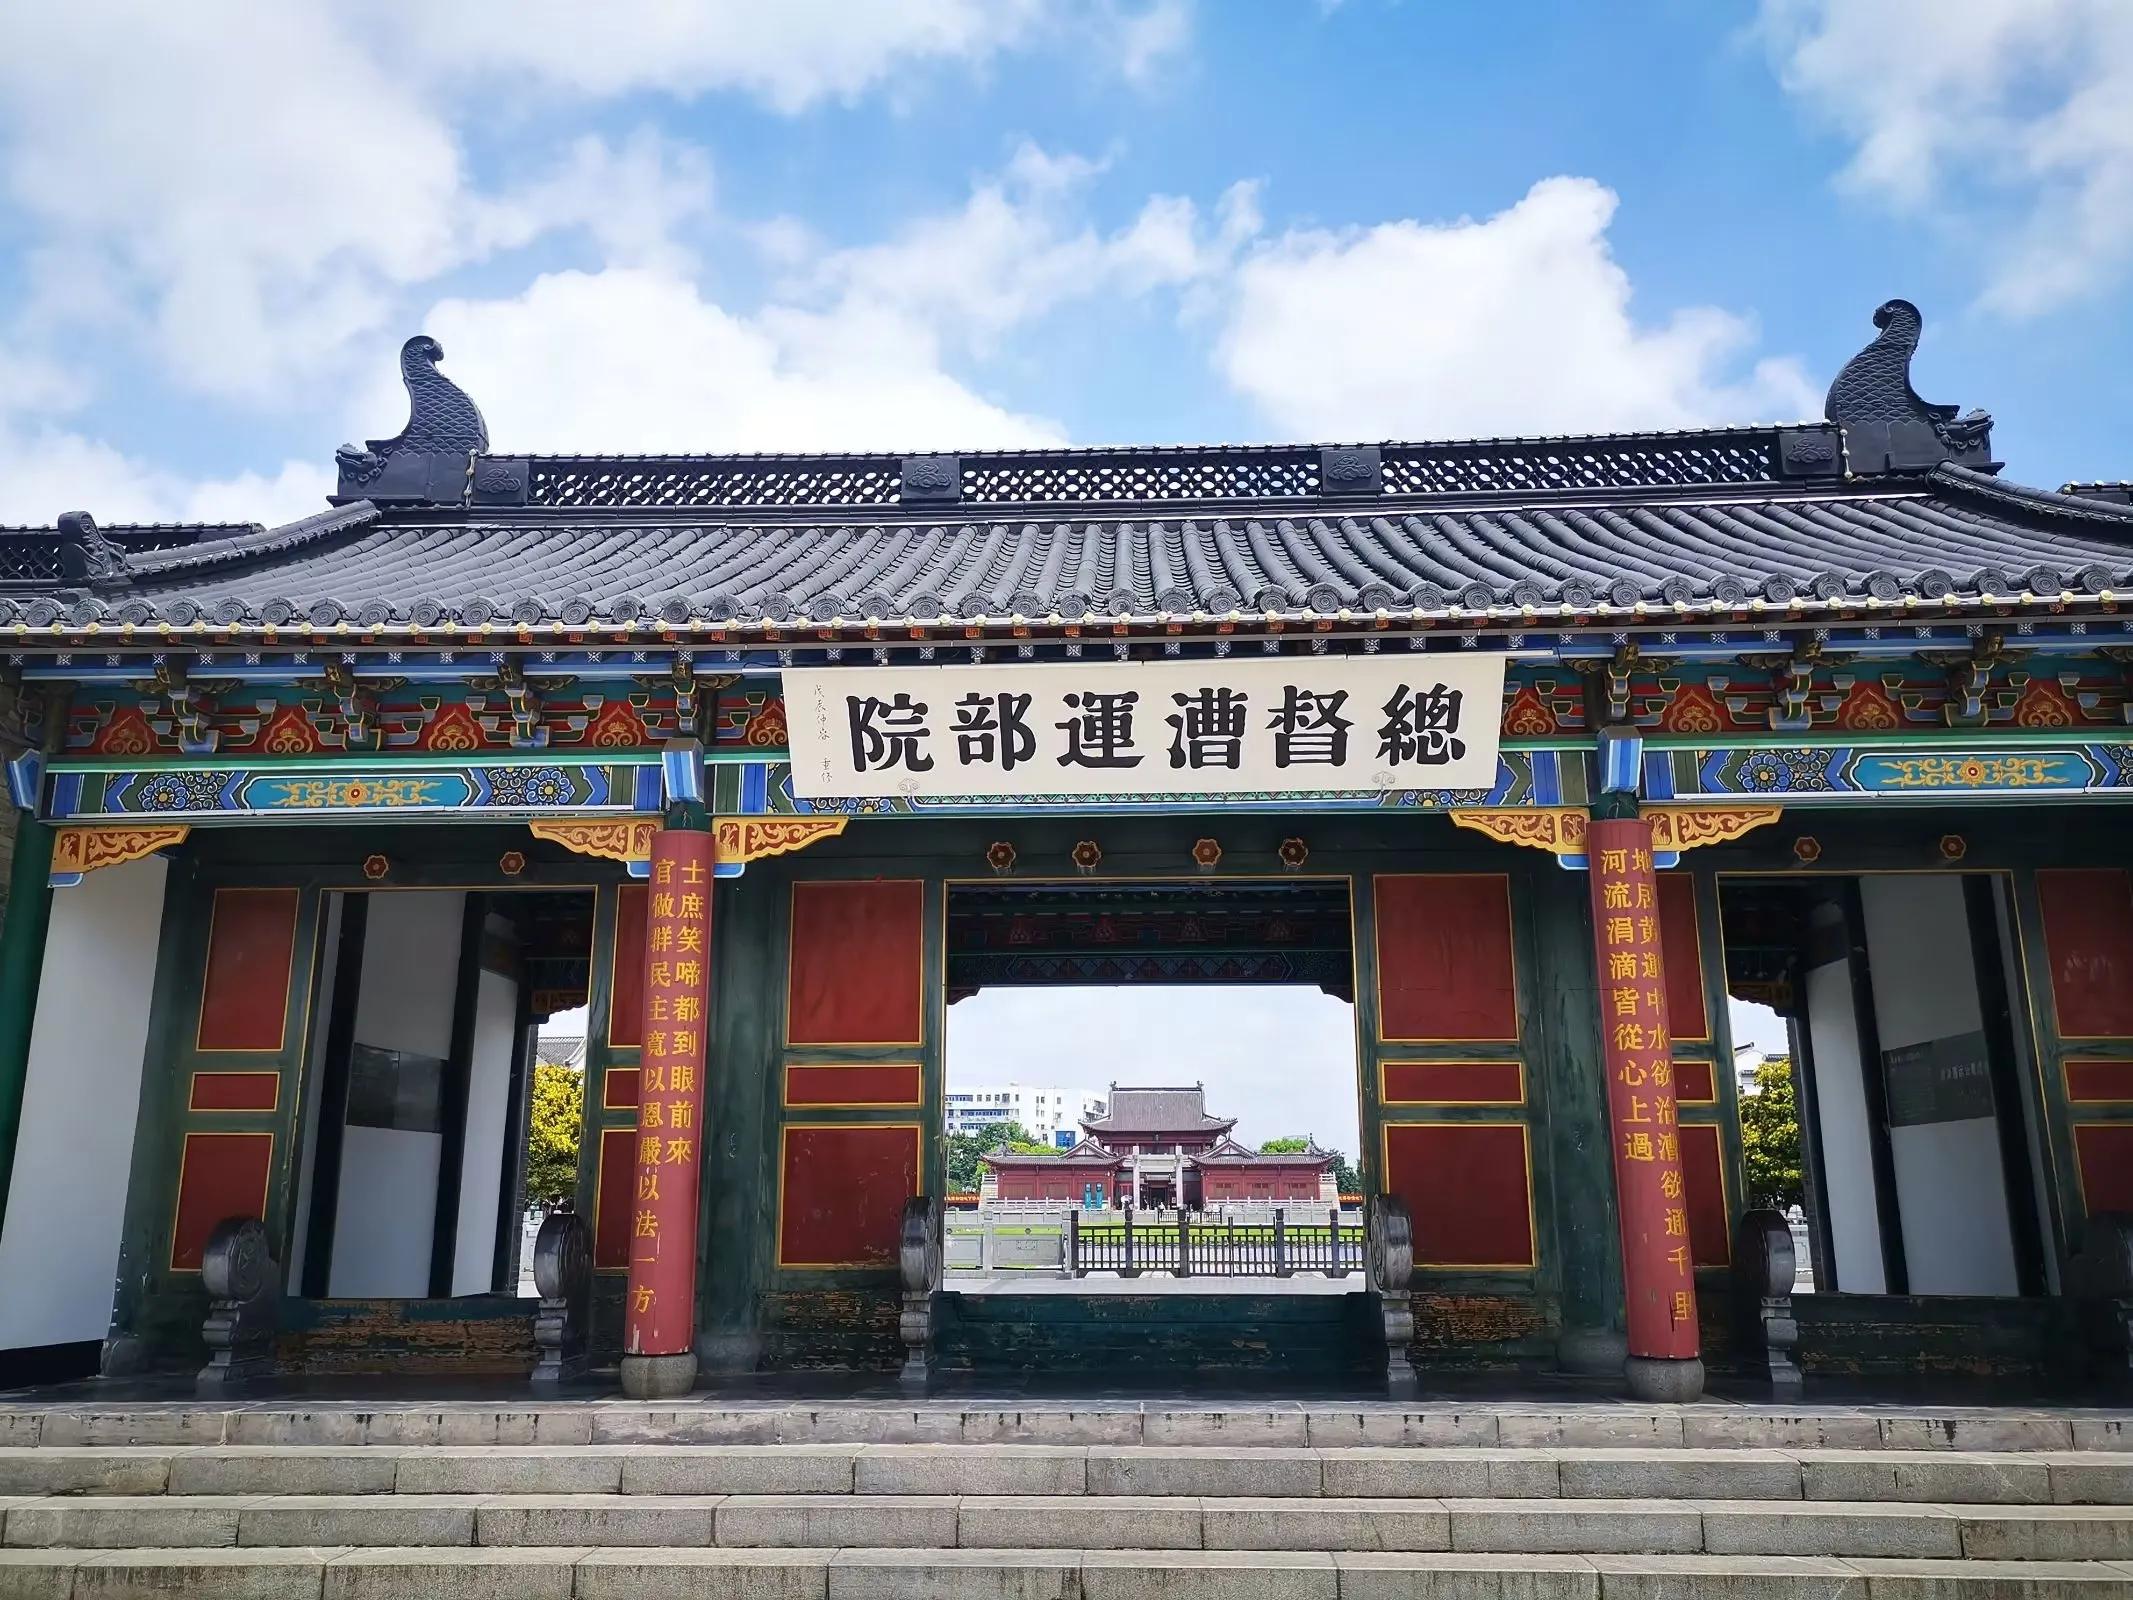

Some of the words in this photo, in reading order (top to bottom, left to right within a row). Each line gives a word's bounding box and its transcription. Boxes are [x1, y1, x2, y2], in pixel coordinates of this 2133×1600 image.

[845, 683, 1466, 772] 總督漕運部院
